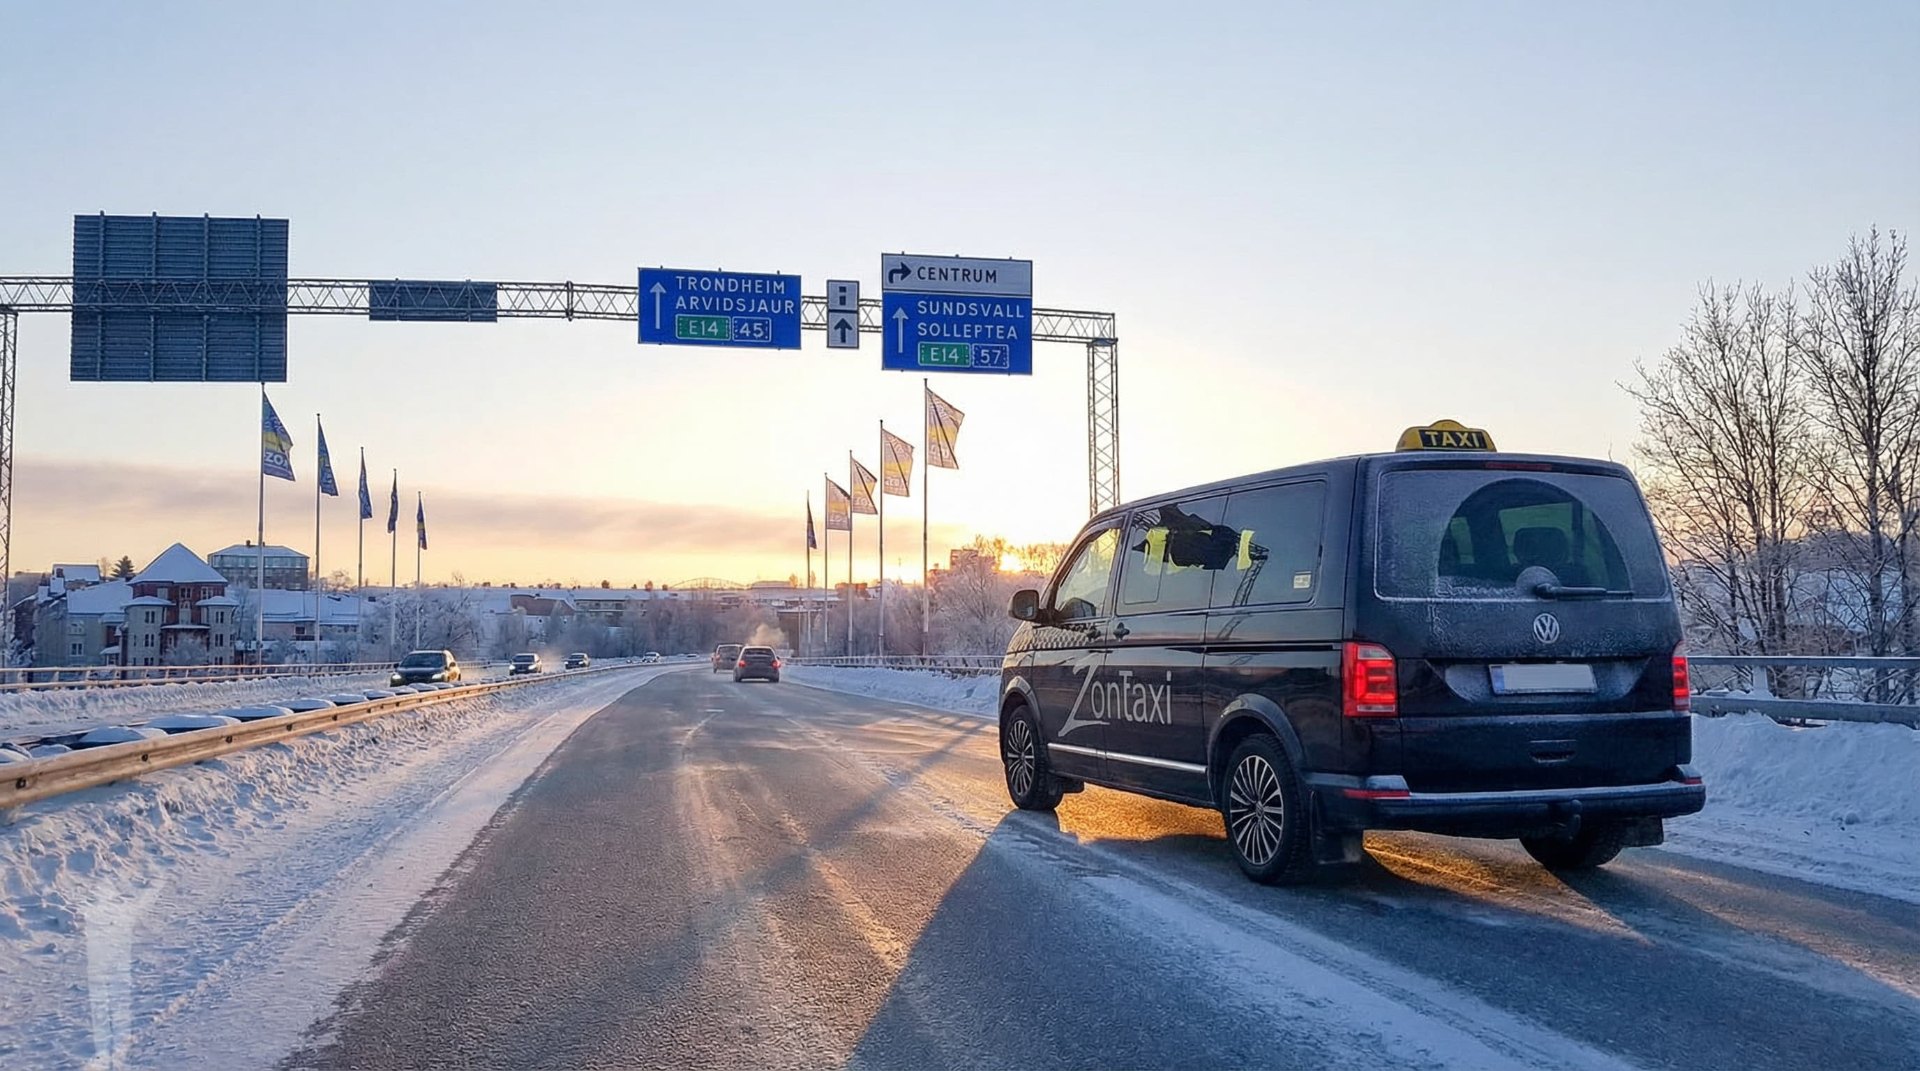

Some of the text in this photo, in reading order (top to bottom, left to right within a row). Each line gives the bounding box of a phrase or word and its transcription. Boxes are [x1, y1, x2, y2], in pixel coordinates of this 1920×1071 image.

[917, 266, 997, 284] CENTRUM
[675, 275, 785, 295] TRONDHEIM
[675, 295, 795, 314] ARVIDSJAUR
[917, 300, 1025, 319] SUNDSVALL
[689, 319, 764, 339] E14 45
[917, 322, 1019, 340] SOLLEPTEA
[930, 347, 1002, 364] E14 57
[1424, 431, 1480, 448] TAXI
[1533, 612, 1560, 644] VW
